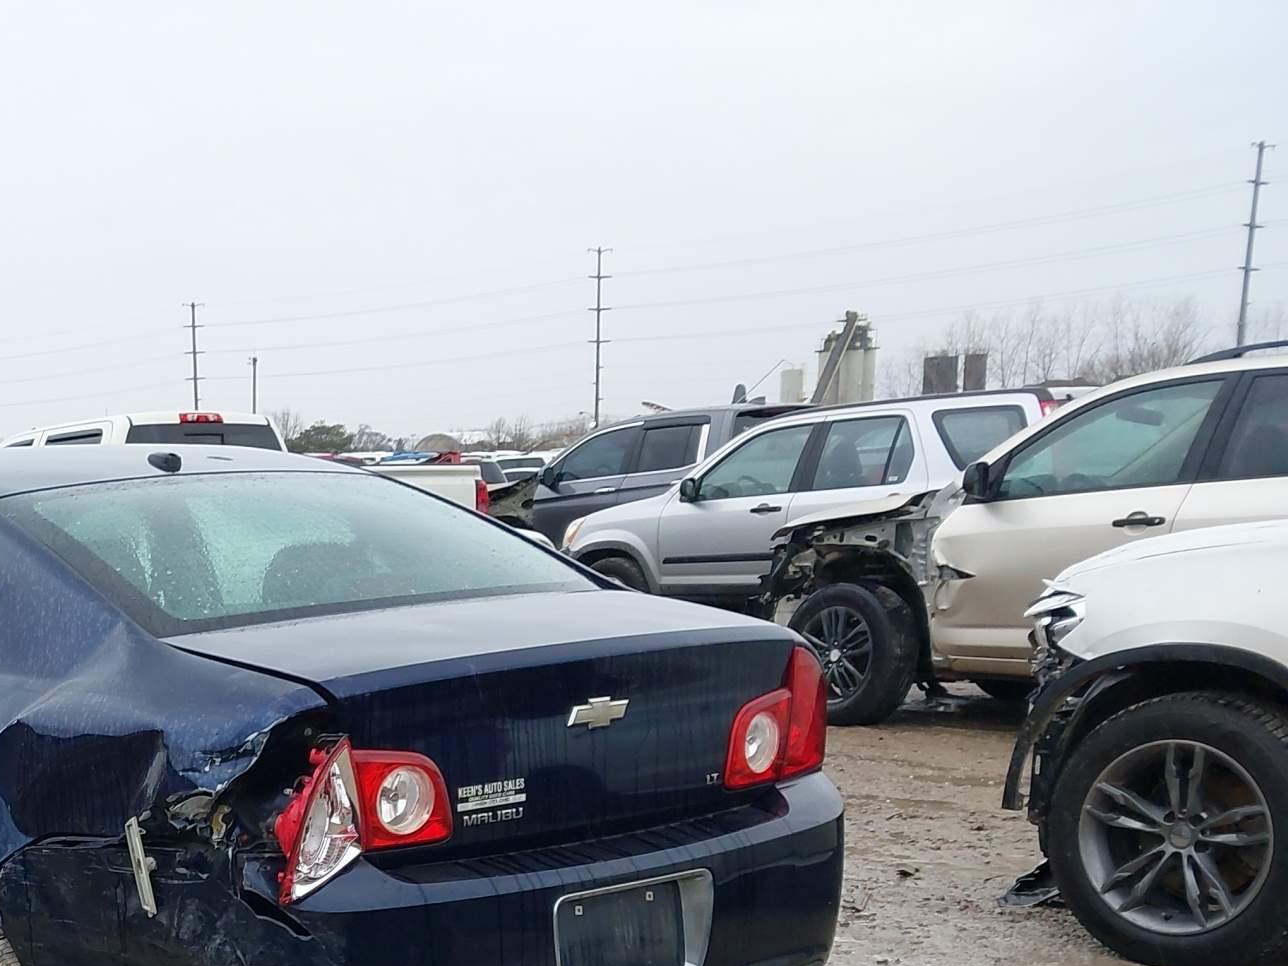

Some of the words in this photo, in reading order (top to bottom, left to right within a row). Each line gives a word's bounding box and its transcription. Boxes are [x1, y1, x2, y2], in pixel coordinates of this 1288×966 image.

[484, 781, 503, 795] AUTO
[503, 777, 525, 791] SALES
[706, 772, 720, 785] LT
[463, 807, 524, 827] MALIBU
